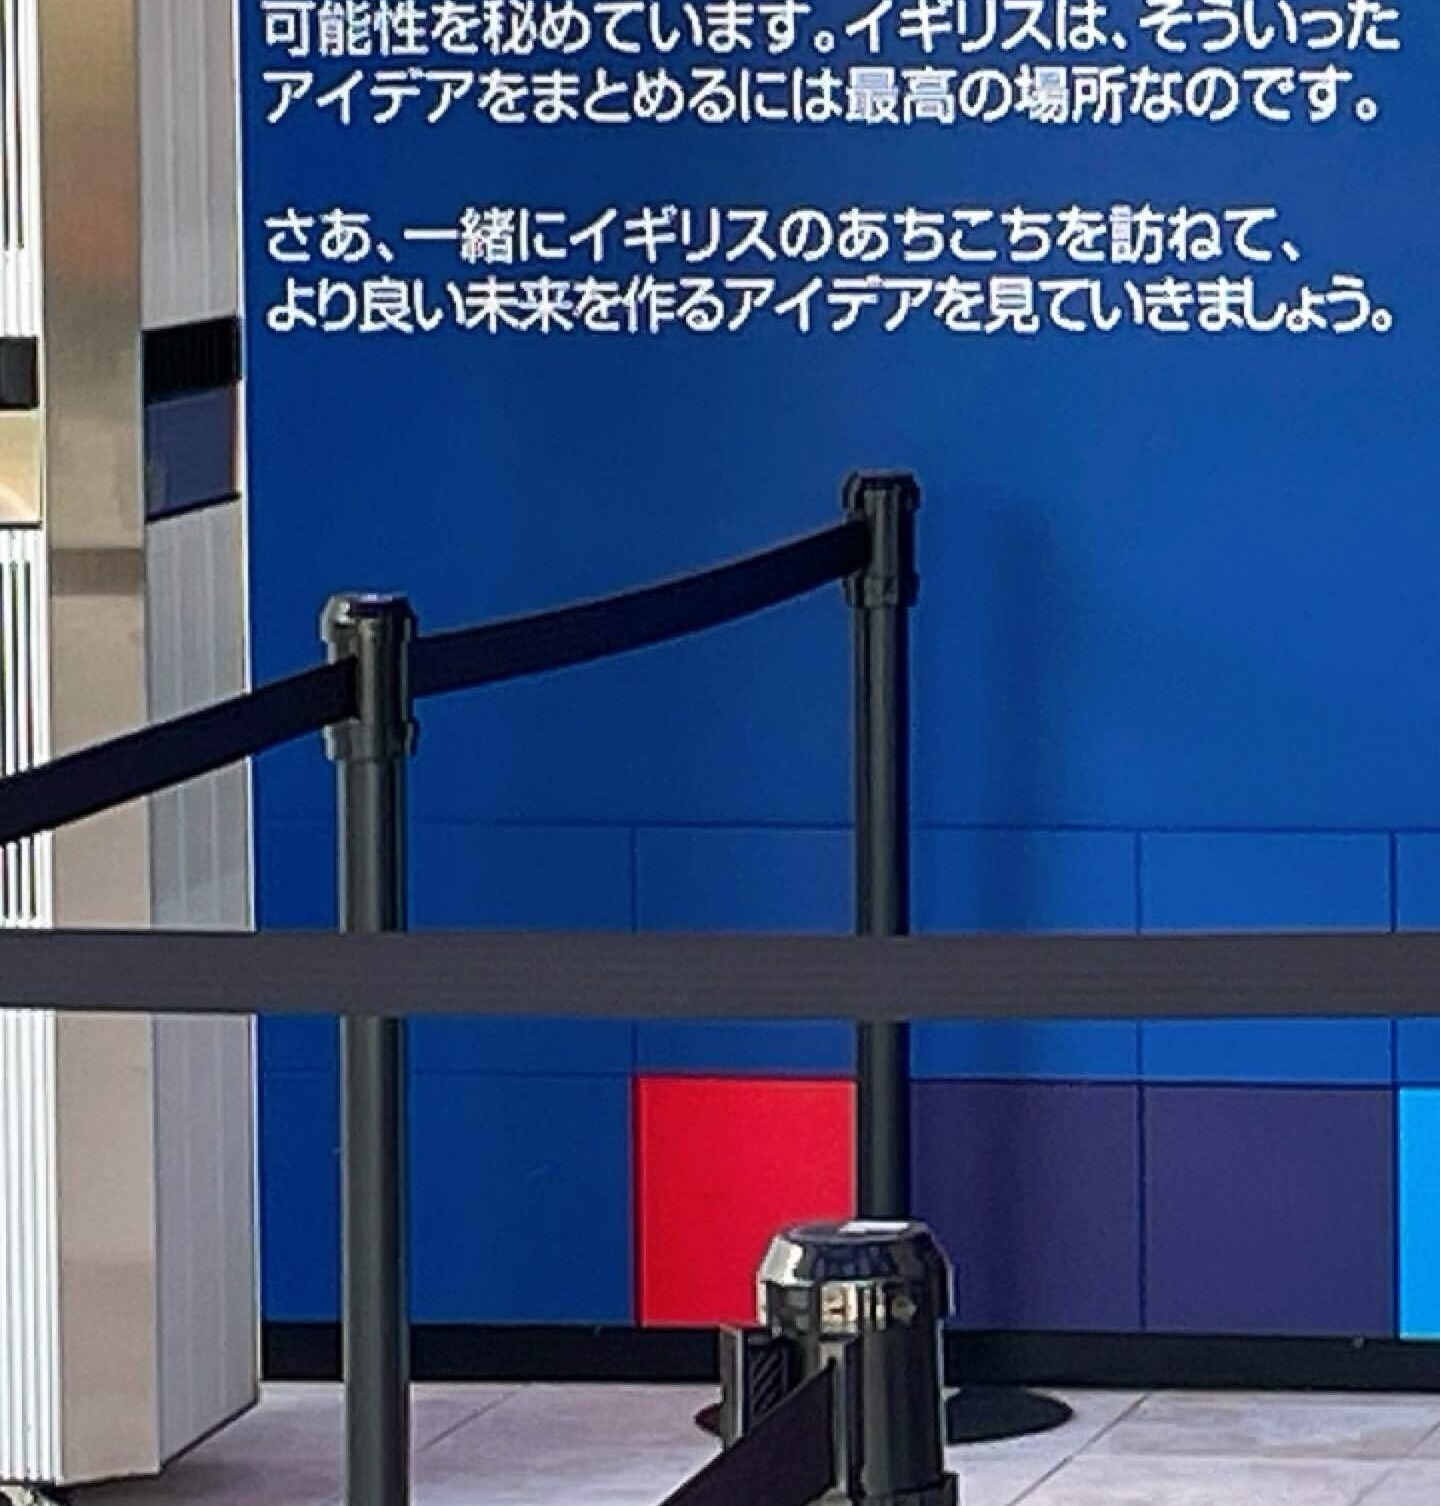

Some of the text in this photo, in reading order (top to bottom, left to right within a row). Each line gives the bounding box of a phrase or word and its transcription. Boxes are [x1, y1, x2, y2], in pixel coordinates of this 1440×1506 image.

[264, 64, 1376, 124] アイデアをまとめるには最高の場所なのです。
[265, 204, 1300, 263] さあ、一緒にイギリスのあちこちを訪ねて、
[268, 275, 1392, 333] より良い未来を作るアイデアを見ていきましょう。
